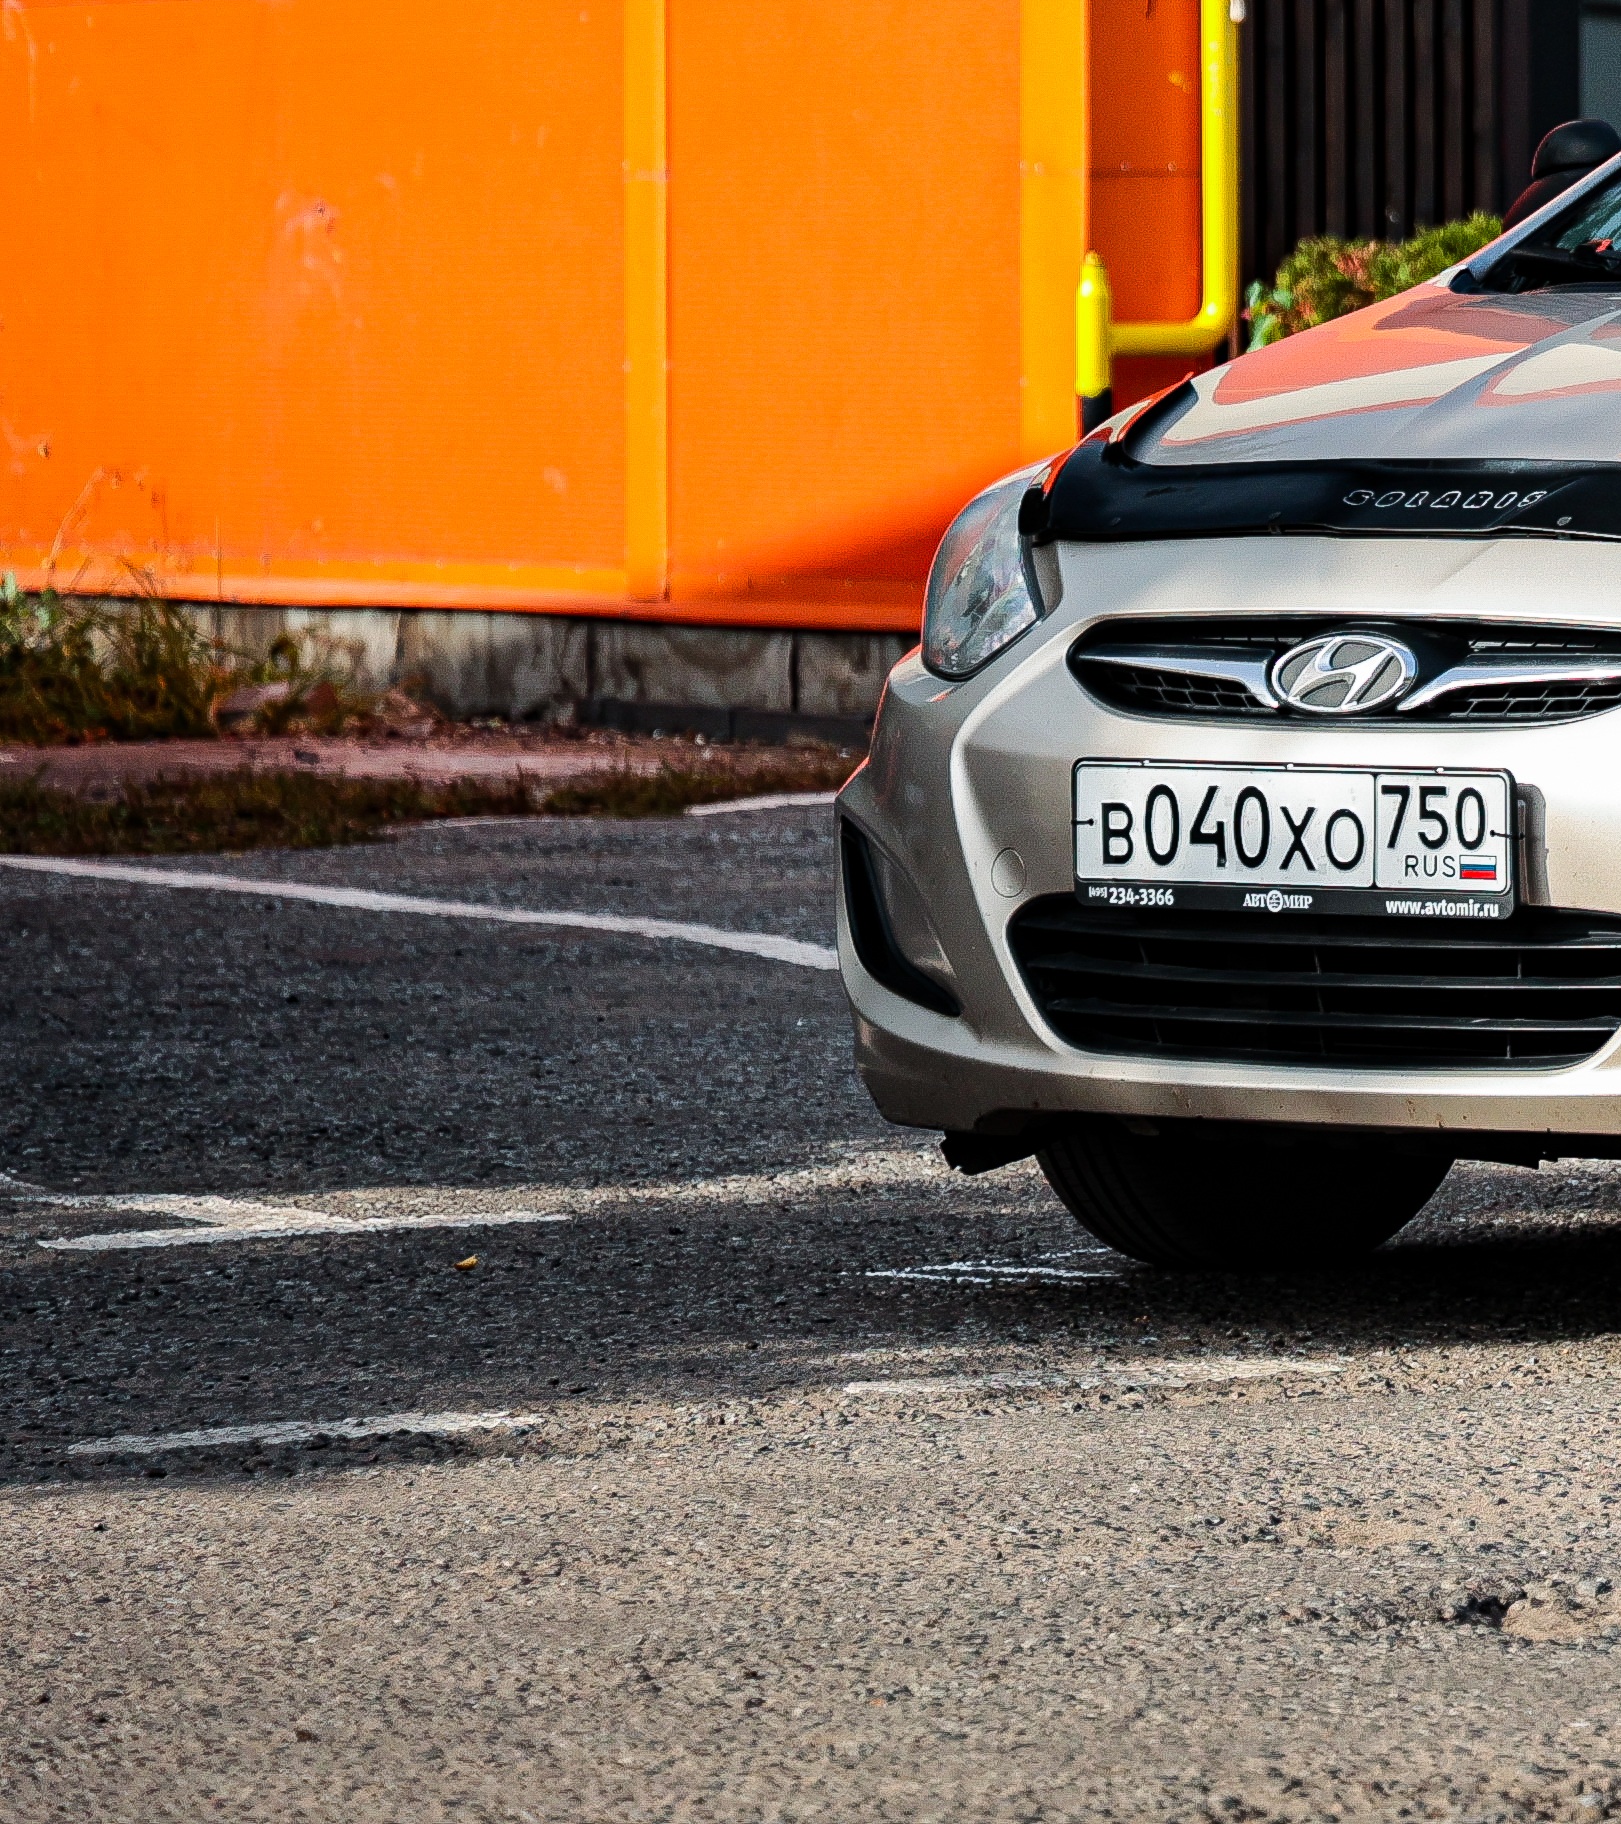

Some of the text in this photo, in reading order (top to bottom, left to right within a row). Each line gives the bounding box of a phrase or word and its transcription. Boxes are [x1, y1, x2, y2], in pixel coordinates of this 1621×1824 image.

[1380, 784, 1487, 851] 750
[1403, 854, 1456, 879] RUS
[1109, 887, 1175, 906] 234-3366
[1385, 898, 1499, 918] www.avtomir.ru
